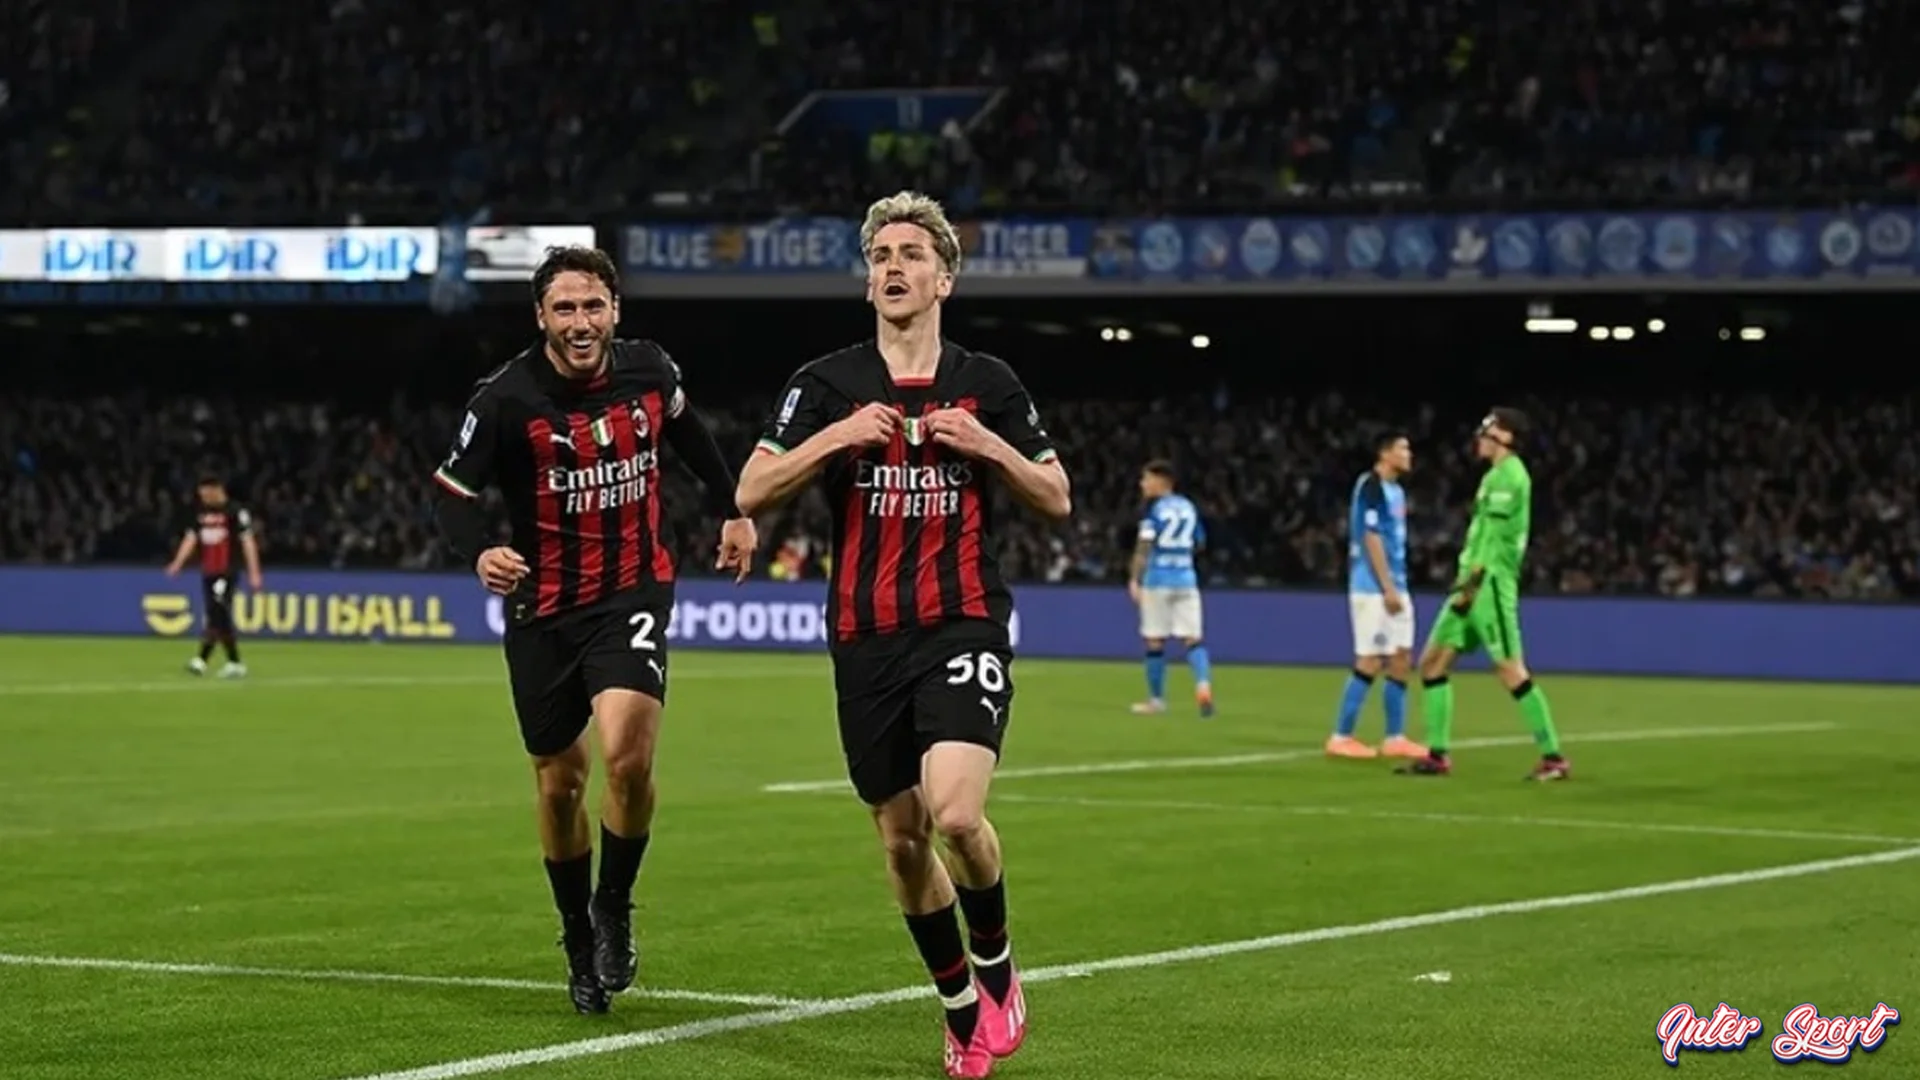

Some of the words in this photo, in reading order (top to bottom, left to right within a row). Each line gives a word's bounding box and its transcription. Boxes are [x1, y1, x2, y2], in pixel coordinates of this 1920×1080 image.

[626, 225, 710, 268] BLUE
[549, 447, 658, 492] Emirates
[854, 459, 973, 490] Emirates
[566, 489, 595, 514] FLY
[869, 492, 899, 516] FLY
[902, 490, 959, 517] BETTER
[1158, 508, 1197, 549] 22
[628, 612, 656, 650] 2
[947, 652, 1005, 693] 56
